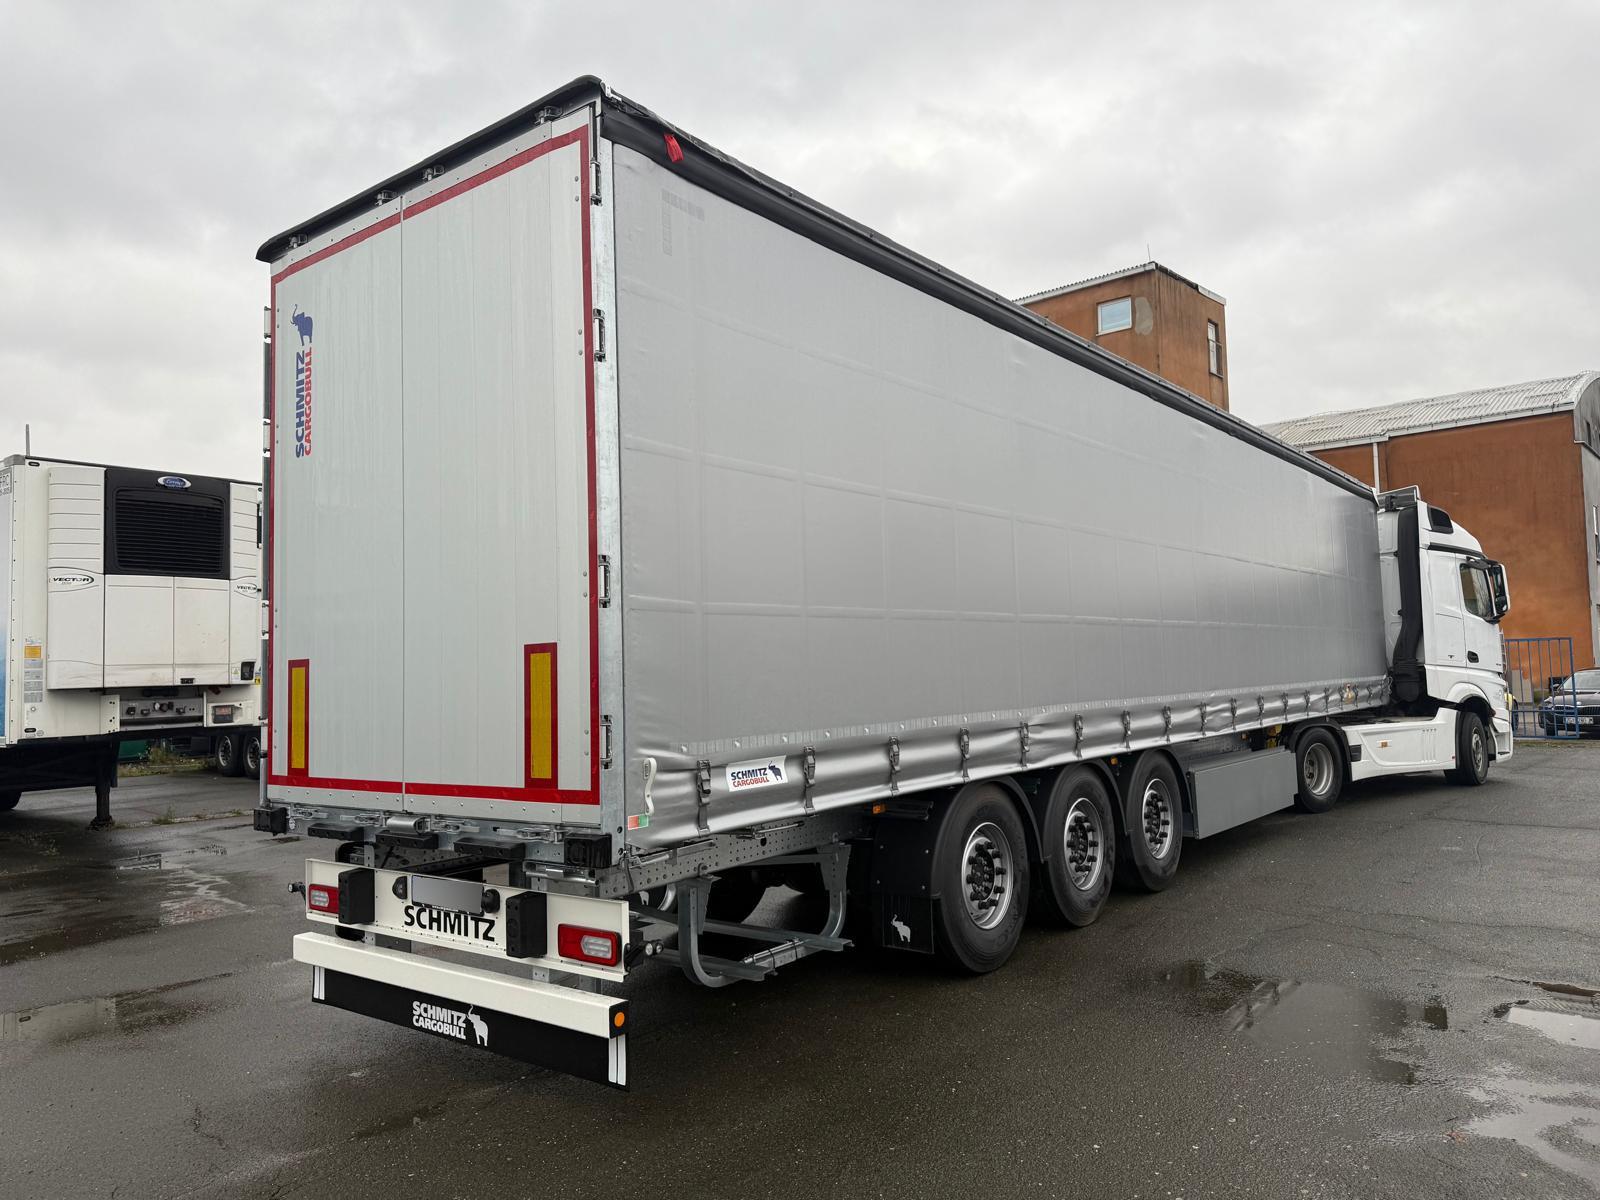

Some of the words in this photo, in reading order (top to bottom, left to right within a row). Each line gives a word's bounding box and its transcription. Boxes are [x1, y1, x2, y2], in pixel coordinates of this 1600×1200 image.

[295, 351, 305, 458] SCHMITZ
[304, 348, 312, 456] CARGOBULL
[730, 767, 768, 780] SCHMITZ
[732, 776, 769, 787] CARGOBULL
[404, 905, 495, 942] SCHMITZ
[412, 1000, 467, 1028] SCHMITZ
[412, 1015, 467, 1040] CARGOBULL
